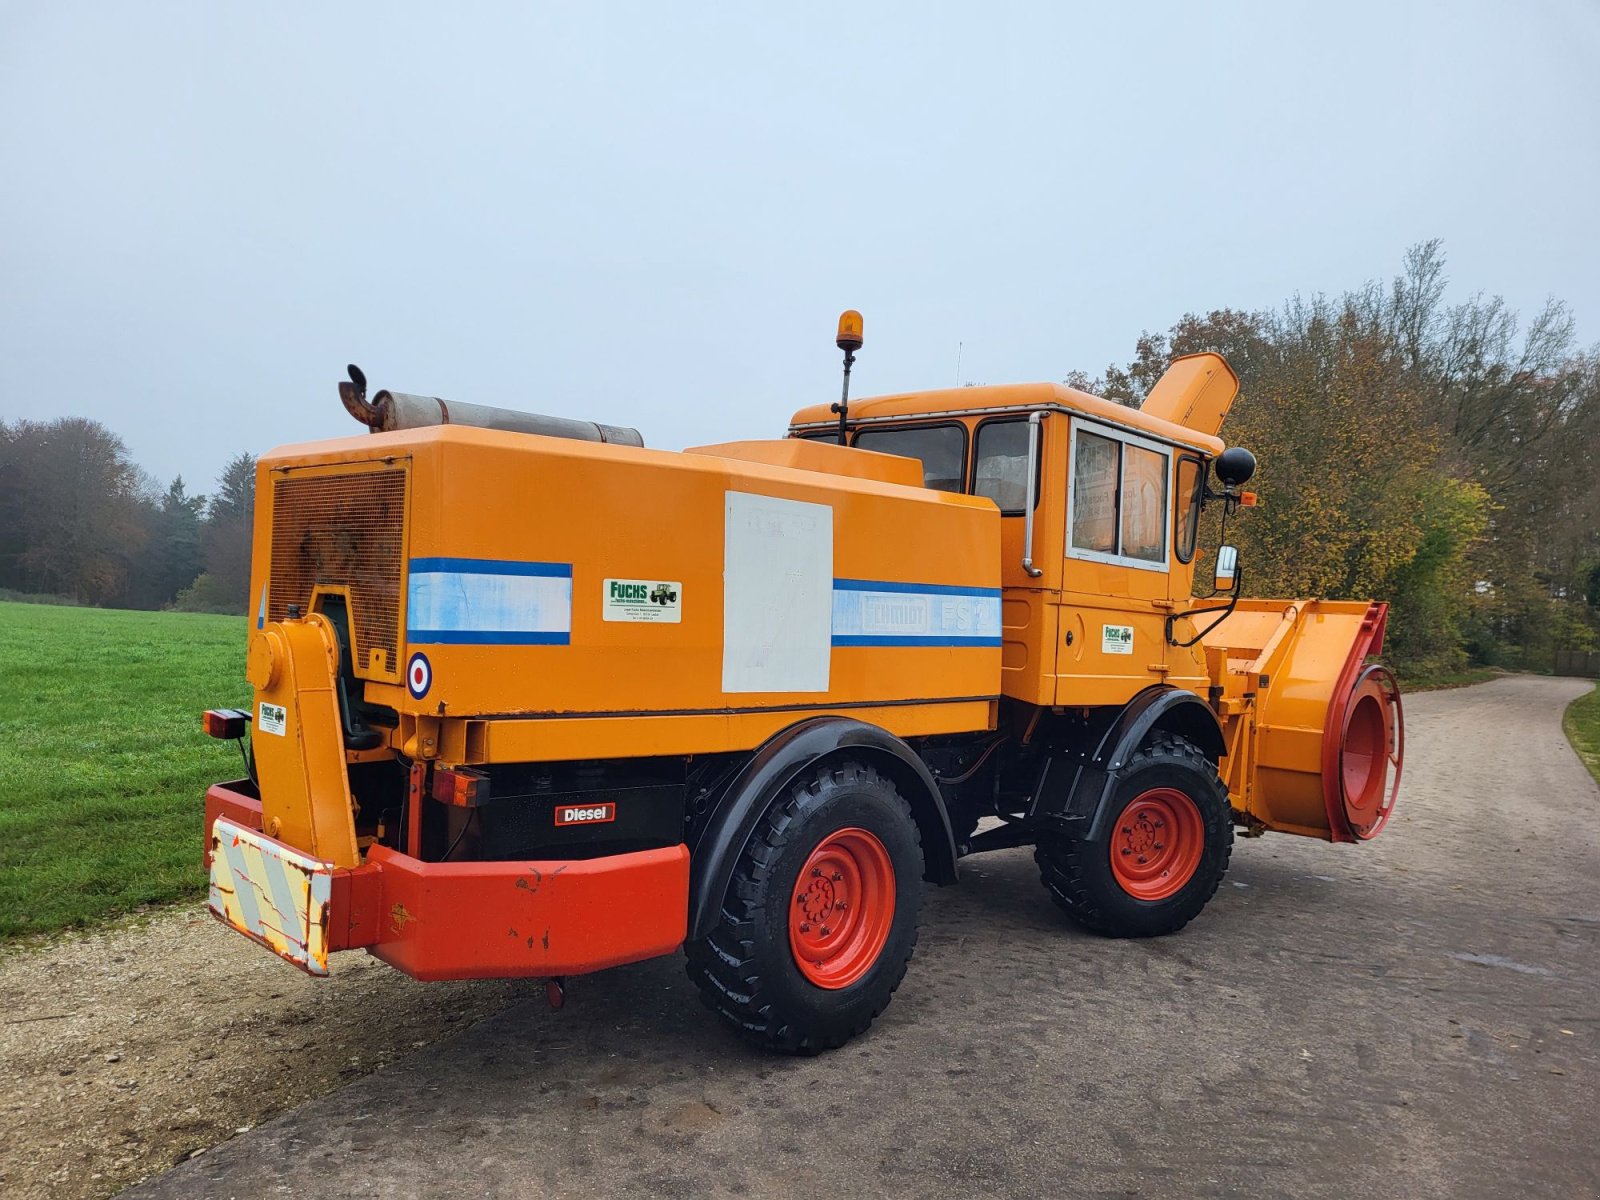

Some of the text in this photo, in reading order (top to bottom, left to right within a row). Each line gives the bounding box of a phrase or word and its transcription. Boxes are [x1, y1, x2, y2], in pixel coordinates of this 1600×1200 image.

[610, 581, 648, 599] FUCHS
[941, 600, 970, 632] FS
[1105, 626, 1120, 638] FUCHS
[262, 704, 275, 717] FUCHS
[564, 806, 607, 822] Diesel
